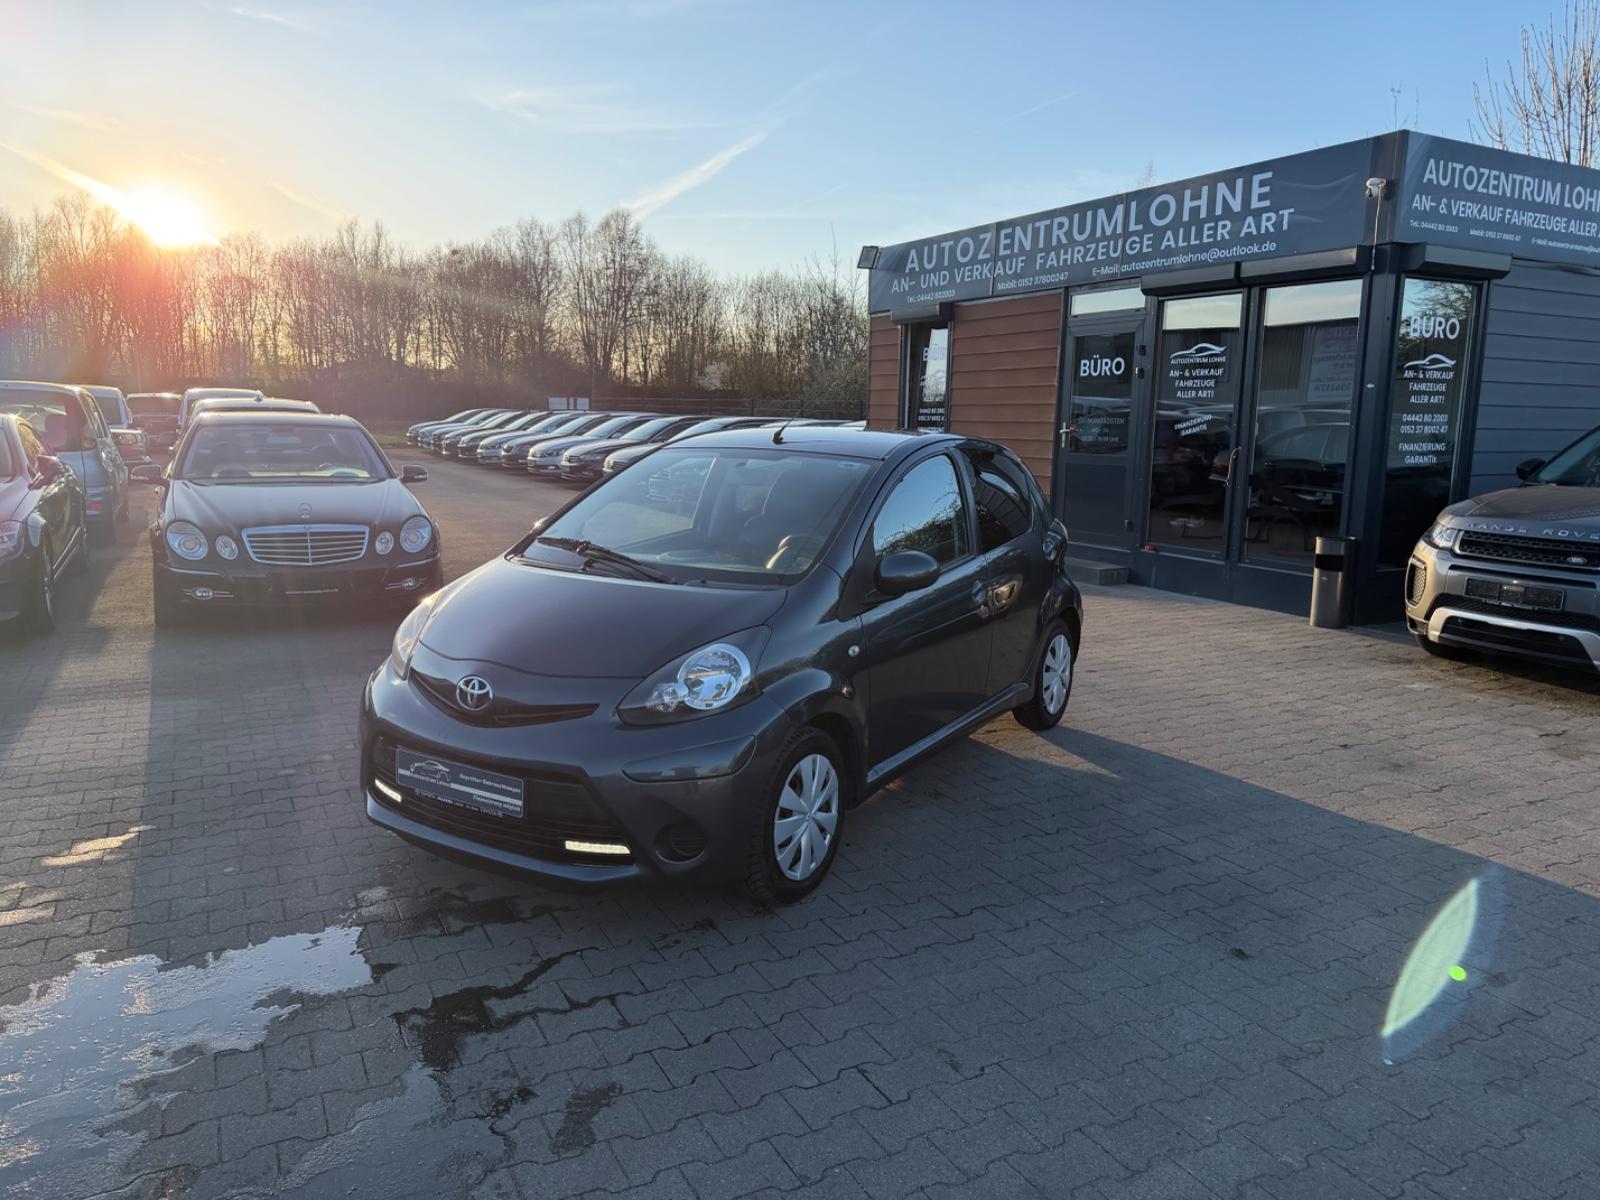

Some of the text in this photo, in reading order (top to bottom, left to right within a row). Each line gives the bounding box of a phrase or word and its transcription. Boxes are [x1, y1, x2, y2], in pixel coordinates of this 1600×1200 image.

[1423, 158, 1561, 206] AUTOZENTRUM
[1412, 193, 1436, 212] AN-
[1439, 198, 1448, 215] &
[1451, 199, 1503, 222] VERKAUF
[1505, 208, 1567, 233] FAHRZEUGE
[1568, 218, 1598, 237] ALLER
[891, 208, 1294, 294] AN- UND VERKAUF FAHRZEUGE ALLER ART
[1121, 241, 1277, 272] autozentrumlohne@outlook.de
[1409, 311, 1460, 340] BÜRO
[1080, 354, 1125, 376] BÜRO
[1191, 368, 1224, 377] VERKAUF
[1425, 370, 1455, 380] VERKAUF
[1175, 380, 1216, 388] FAHRZEUGE
[1408, 382, 1447, 391] FAHRZEUGE
[1176, 390, 1196, 398] ALLER
[1409, 395, 1428, 403] ALLER
